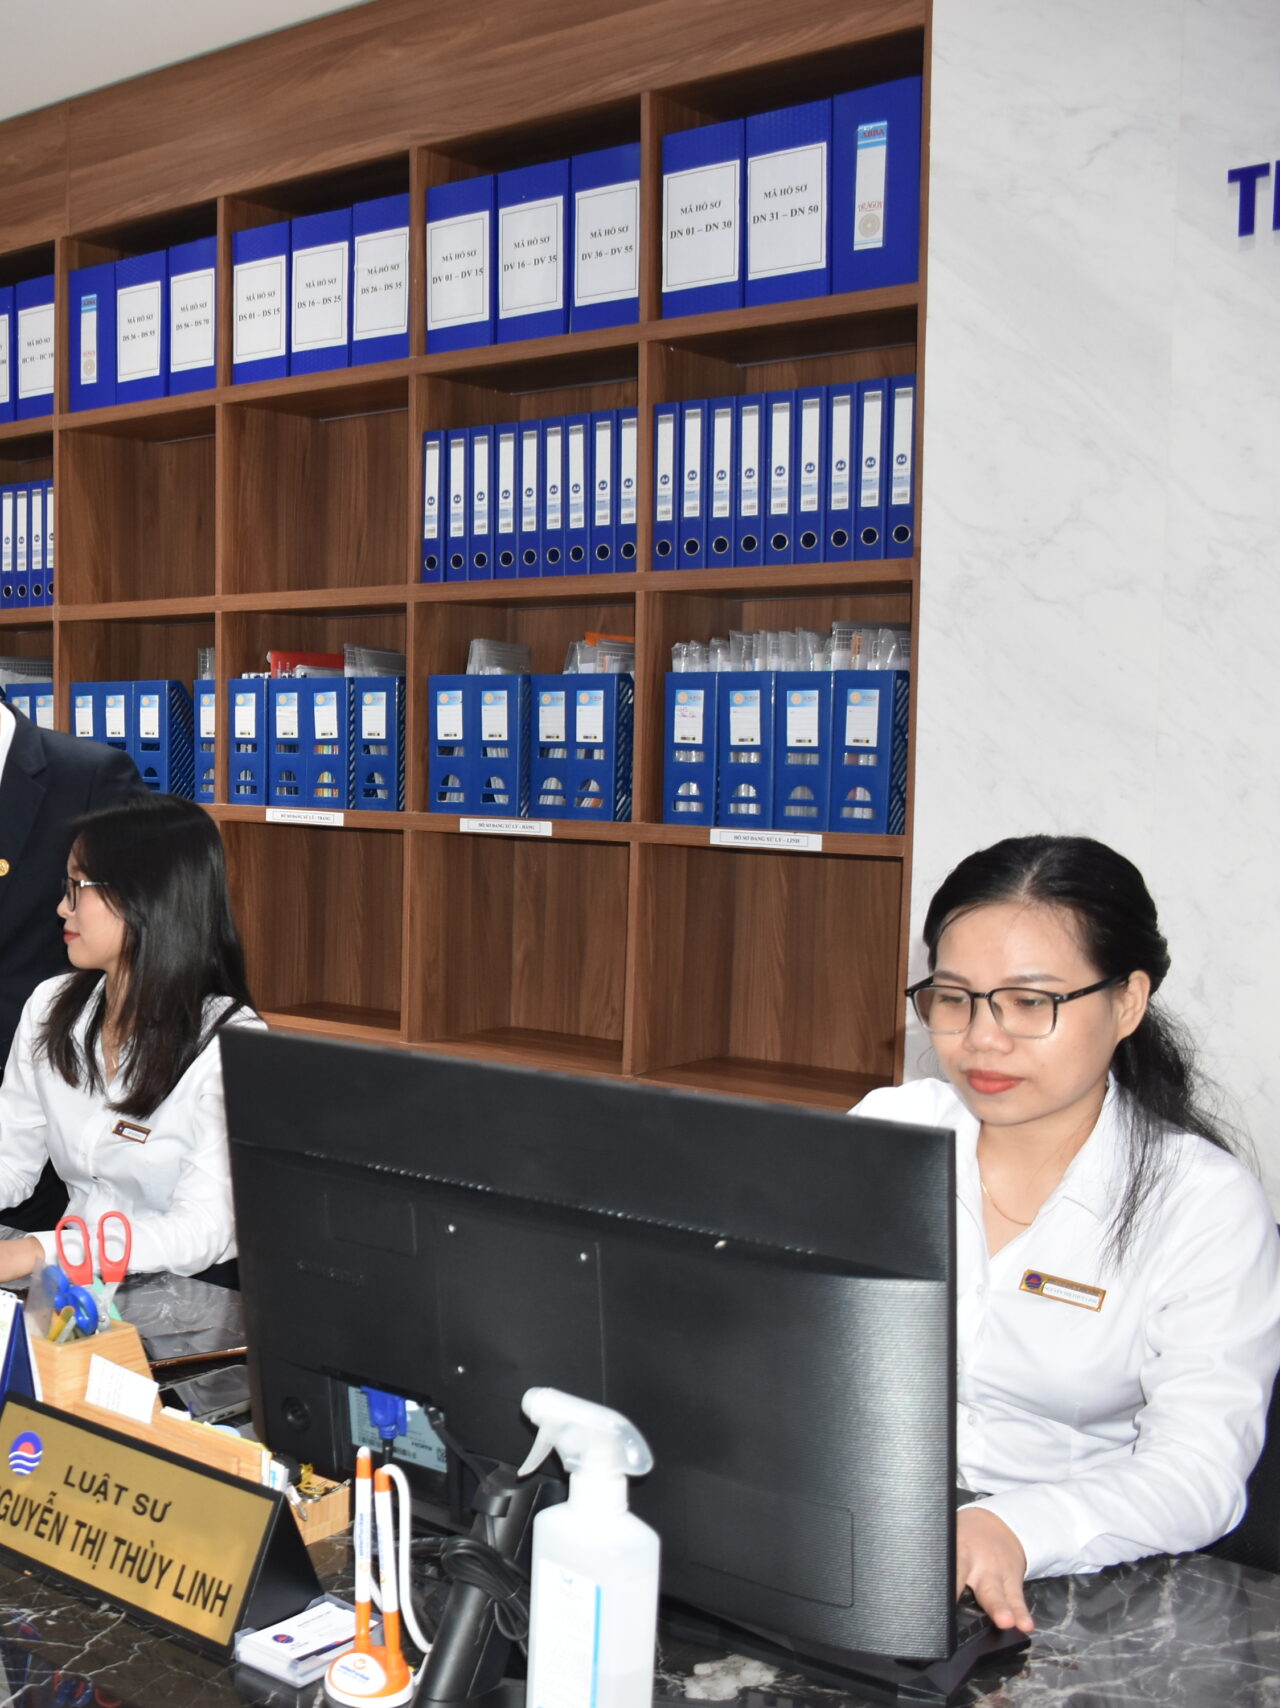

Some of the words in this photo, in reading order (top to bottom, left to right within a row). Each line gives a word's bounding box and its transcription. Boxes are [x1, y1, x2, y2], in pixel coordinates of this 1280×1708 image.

[753, 213, 767, 225] DN
[769, 210, 779, 221] 31
[790, 207, 806, 219] DN
[808, 204, 819, 215] 50
[670, 228, 684, 240] DN
[686, 226, 695, 237] 01
[705, 222, 720, 234] DN
[722, 220, 732, 231] 30
[581, 252, 593, 261] DV
[595, 250, 603, 259] 36
[611, 247, 623, 256] DV
[624, 245, 633, 254] 55
[504, 262, 516, 272] DV
[518, 260, 526, 269] 16
[534, 257, 546, 267] DV
[548, 255, 557, 264] 35
[433, 275, 444, 285] DV
[445, 273, 453, 282] 01
[461, 270, 473, 279] DV
[475, 268, 484, 277] 15
[361, 286, 370, 295] DS
[371, 285, 378, 293] 26
[384, 283, 394, 291] DS
[64, 1465, 128, 1506] LUẬT
[132, 1494, 172, 1523] SƯ
[70, 1520, 108, 1570] THỊ
[109, 1536, 173, 1591] THÙY
[172, 1565, 233, 1618] LINH
